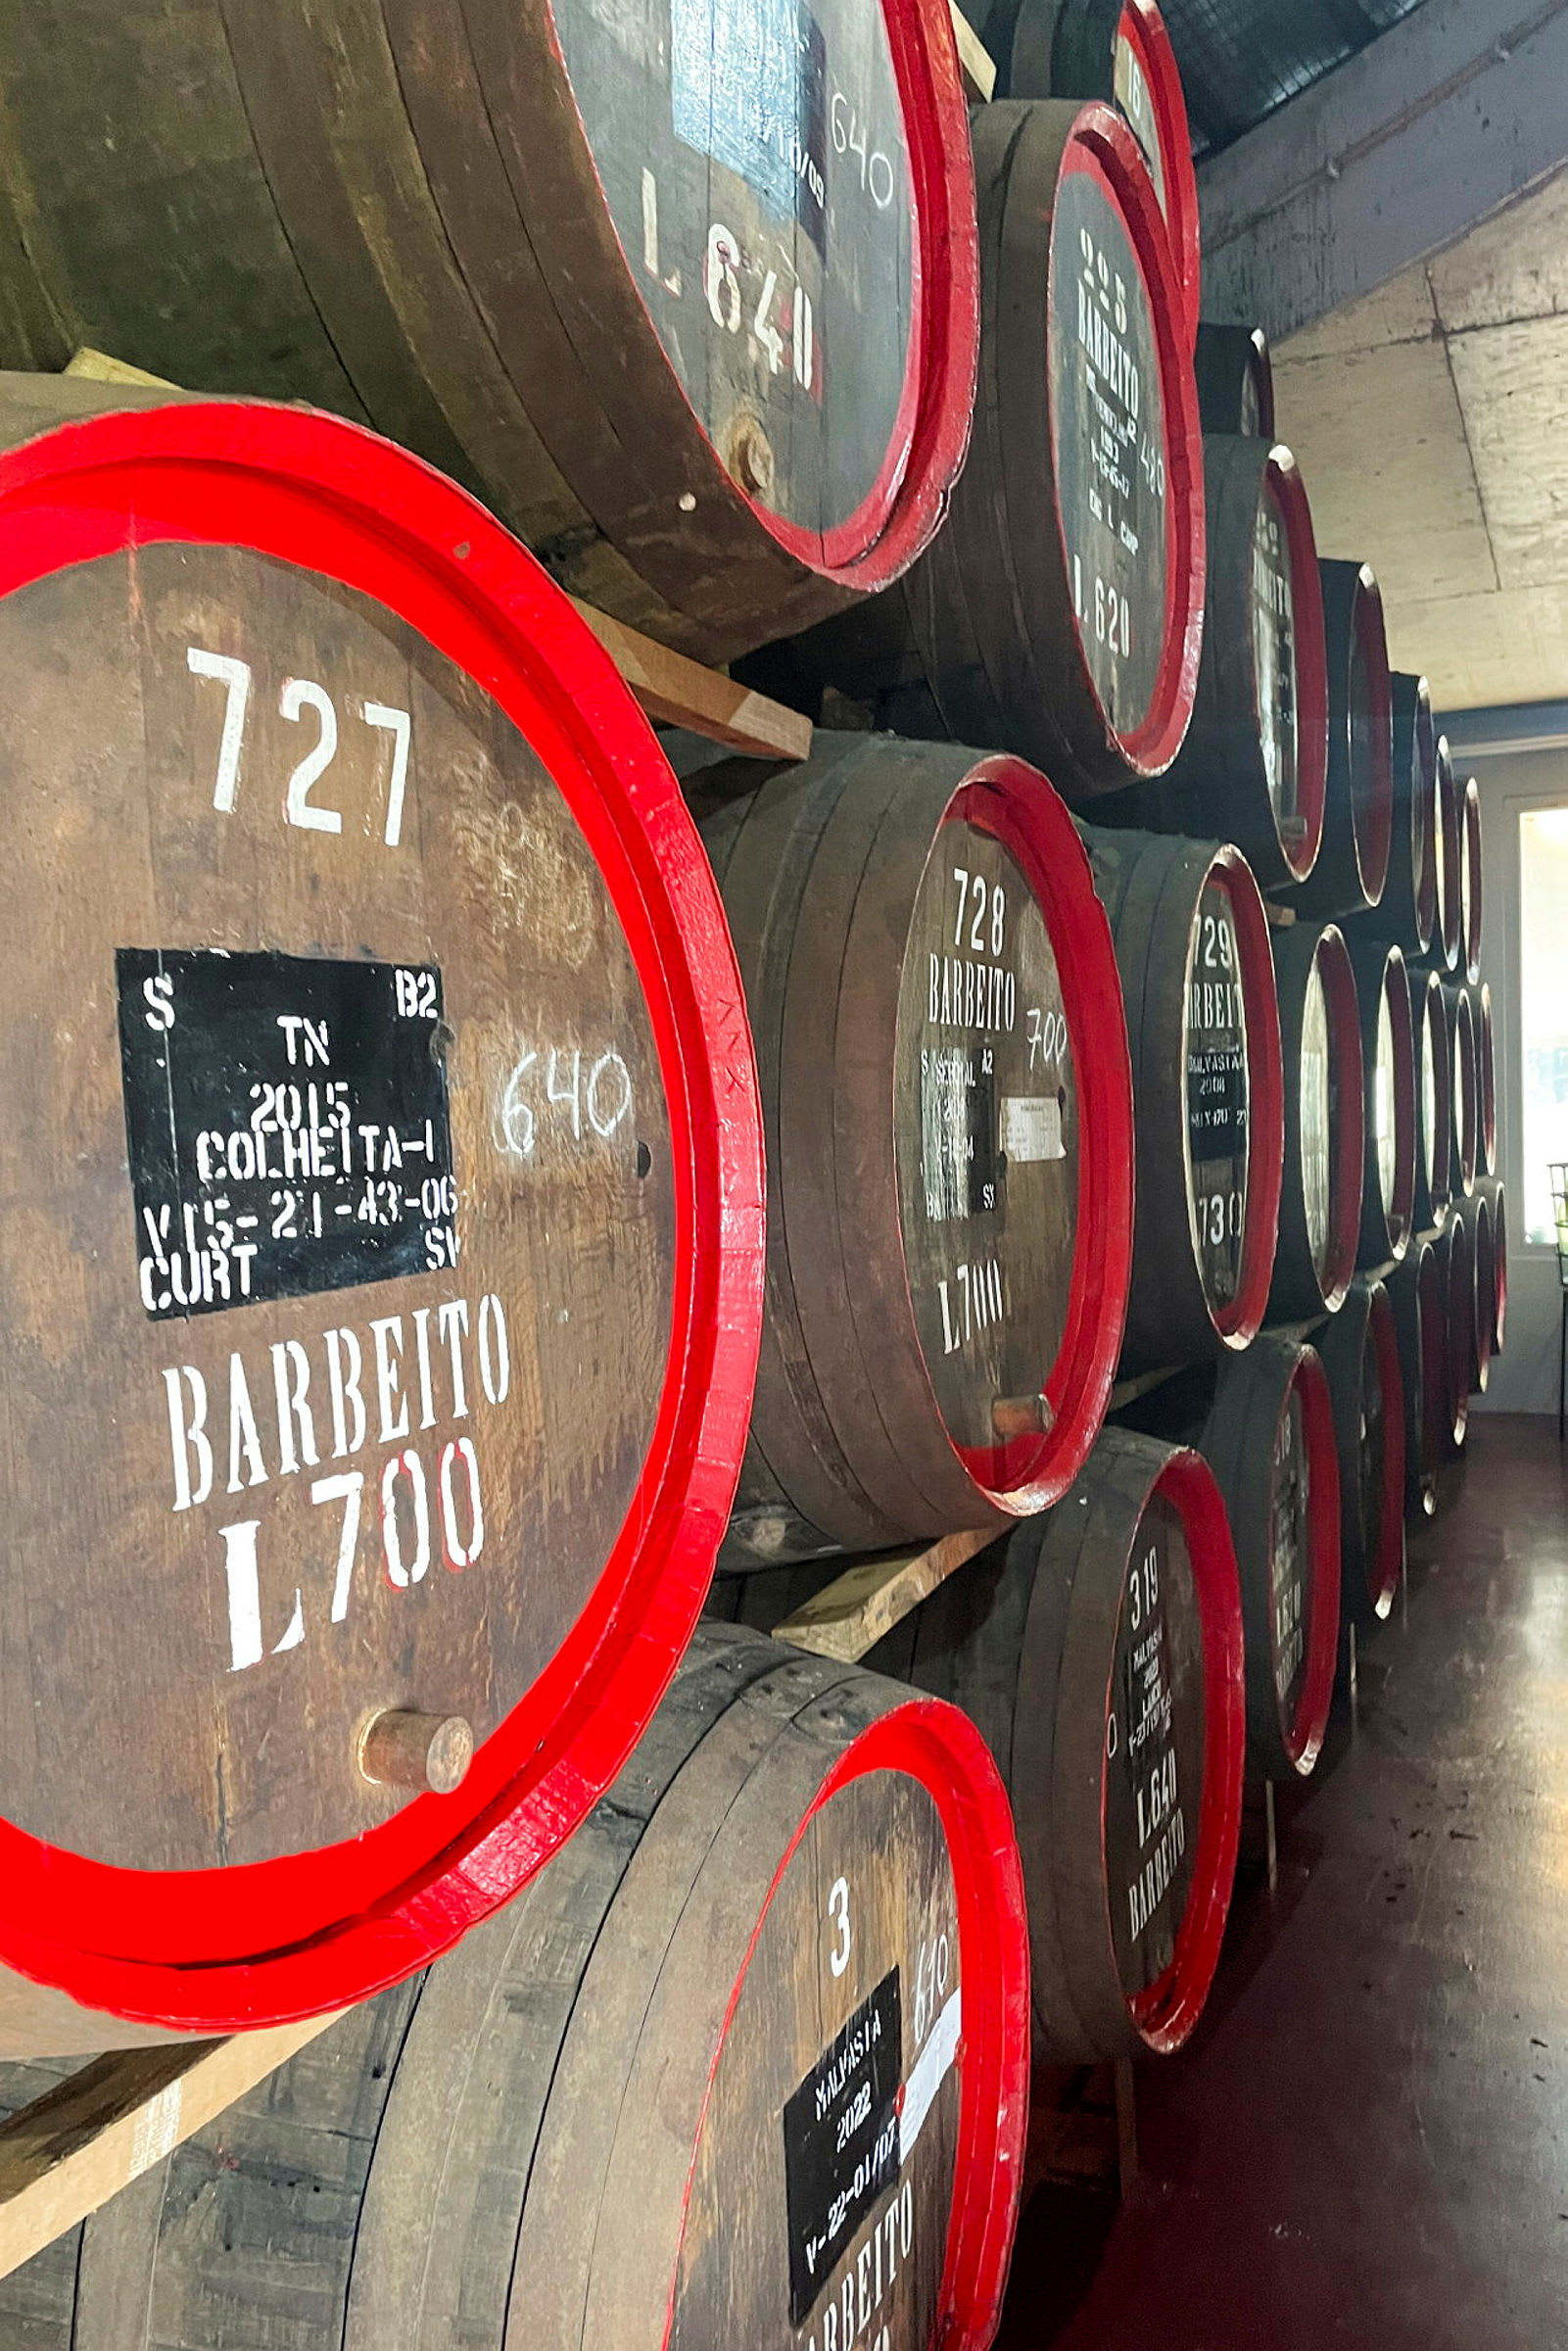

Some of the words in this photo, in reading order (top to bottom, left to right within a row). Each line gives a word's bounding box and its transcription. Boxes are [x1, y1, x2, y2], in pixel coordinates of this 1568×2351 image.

[832, 92, 893, 209] 640
[1077, 277, 1138, 419] BARBEITO
[186, 648, 410, 846] 727
[954, 868, 1006, 957] 728
[1192, 914, 1232, 970] 729
[143, 976, 175, 1032] S
[395, 969, 438, 1018] B2
[929, 952, 1016, 1032] BARBEITO
[277, 1015, 329, 1067] TN
[1026, 1008, 1067, 1071] 700
[250, 1082, 351, 1132] 2015
[495, 1052, 632, 1156] 640
[140, 1244, 258, 1311] CURT
[162, 1293, 509, 1511] BARBEITO
[1129, 1545, 1158, 1631] 319
[1128, 1807, 1185, 1942] BARBEITO
[829, 1876, 850, 1977] 3
[815, 2009, 880, 2122] MALVASIA
[836, 2082, 871, 2153] 2022
